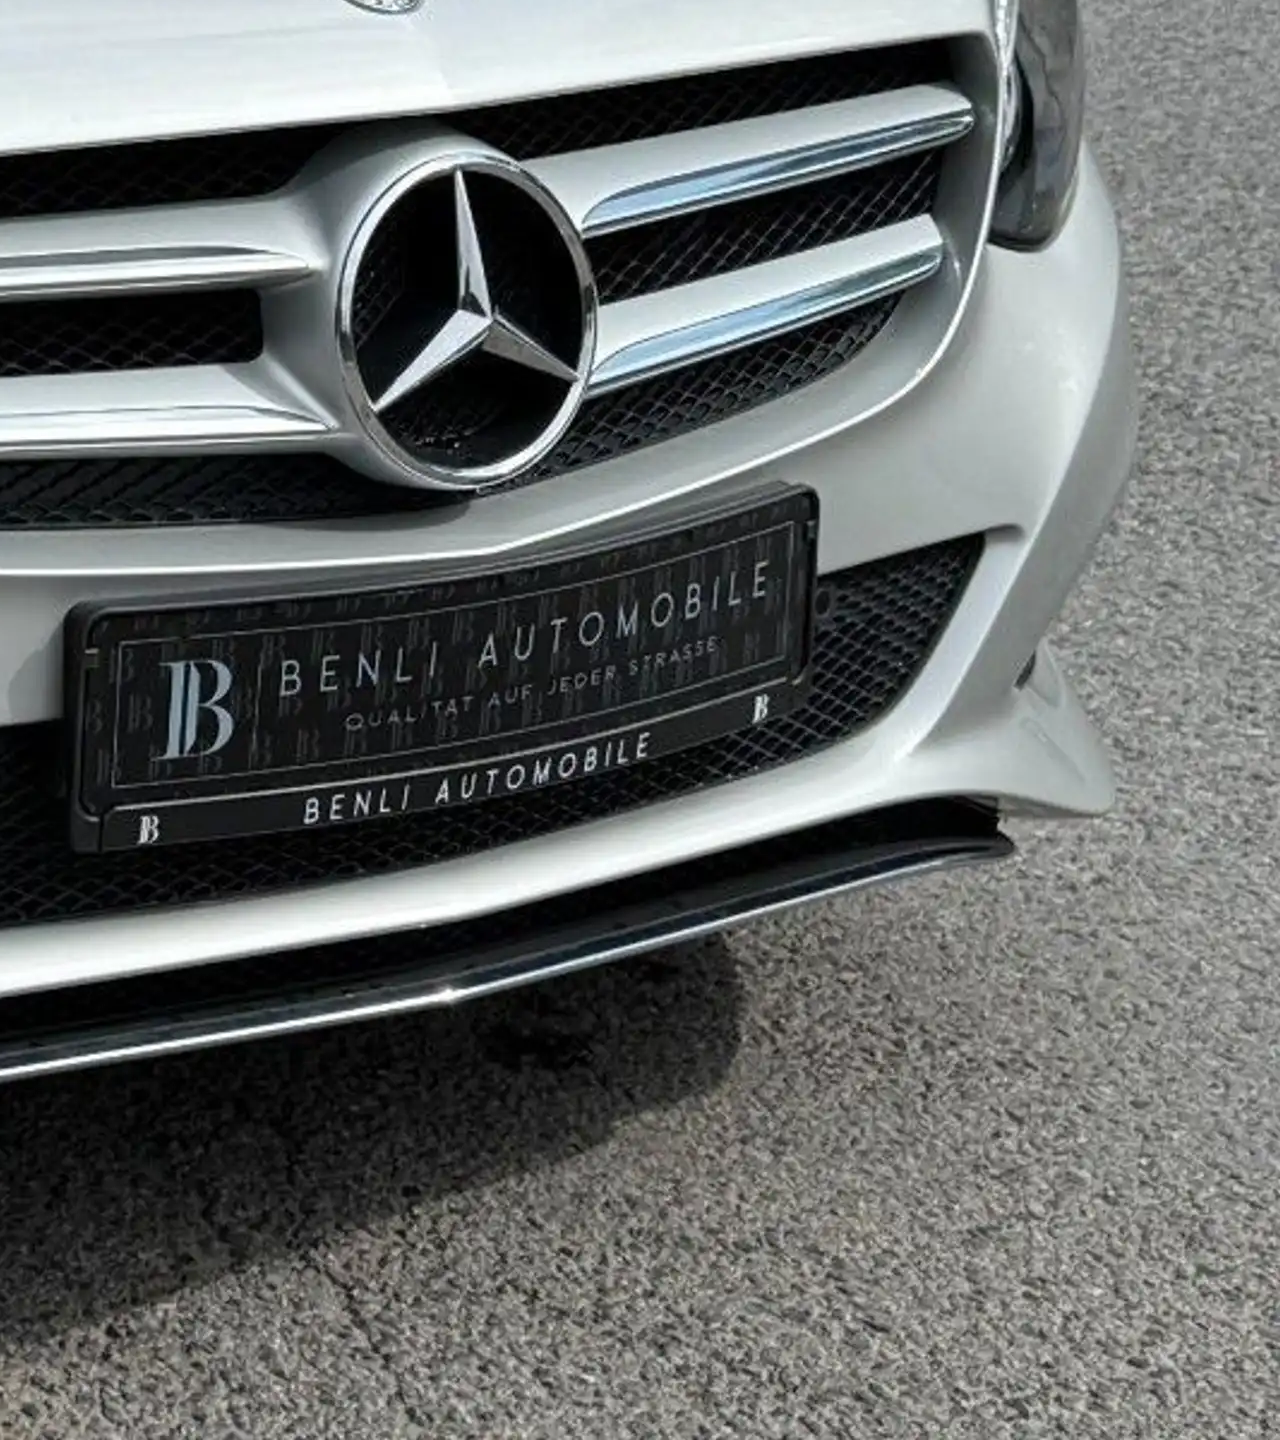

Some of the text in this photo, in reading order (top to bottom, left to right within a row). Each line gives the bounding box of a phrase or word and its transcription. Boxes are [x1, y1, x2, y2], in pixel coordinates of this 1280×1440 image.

[280, 560, 770, 698] BENLI AUTOMOBILE
[487, 683, 533, 708] AUF
[547, 664, 617, 697] JEDER
[627, 635, 719, 677] STRASSE
[303, 731, 653, 825] BENLI AUTOMOBILE
